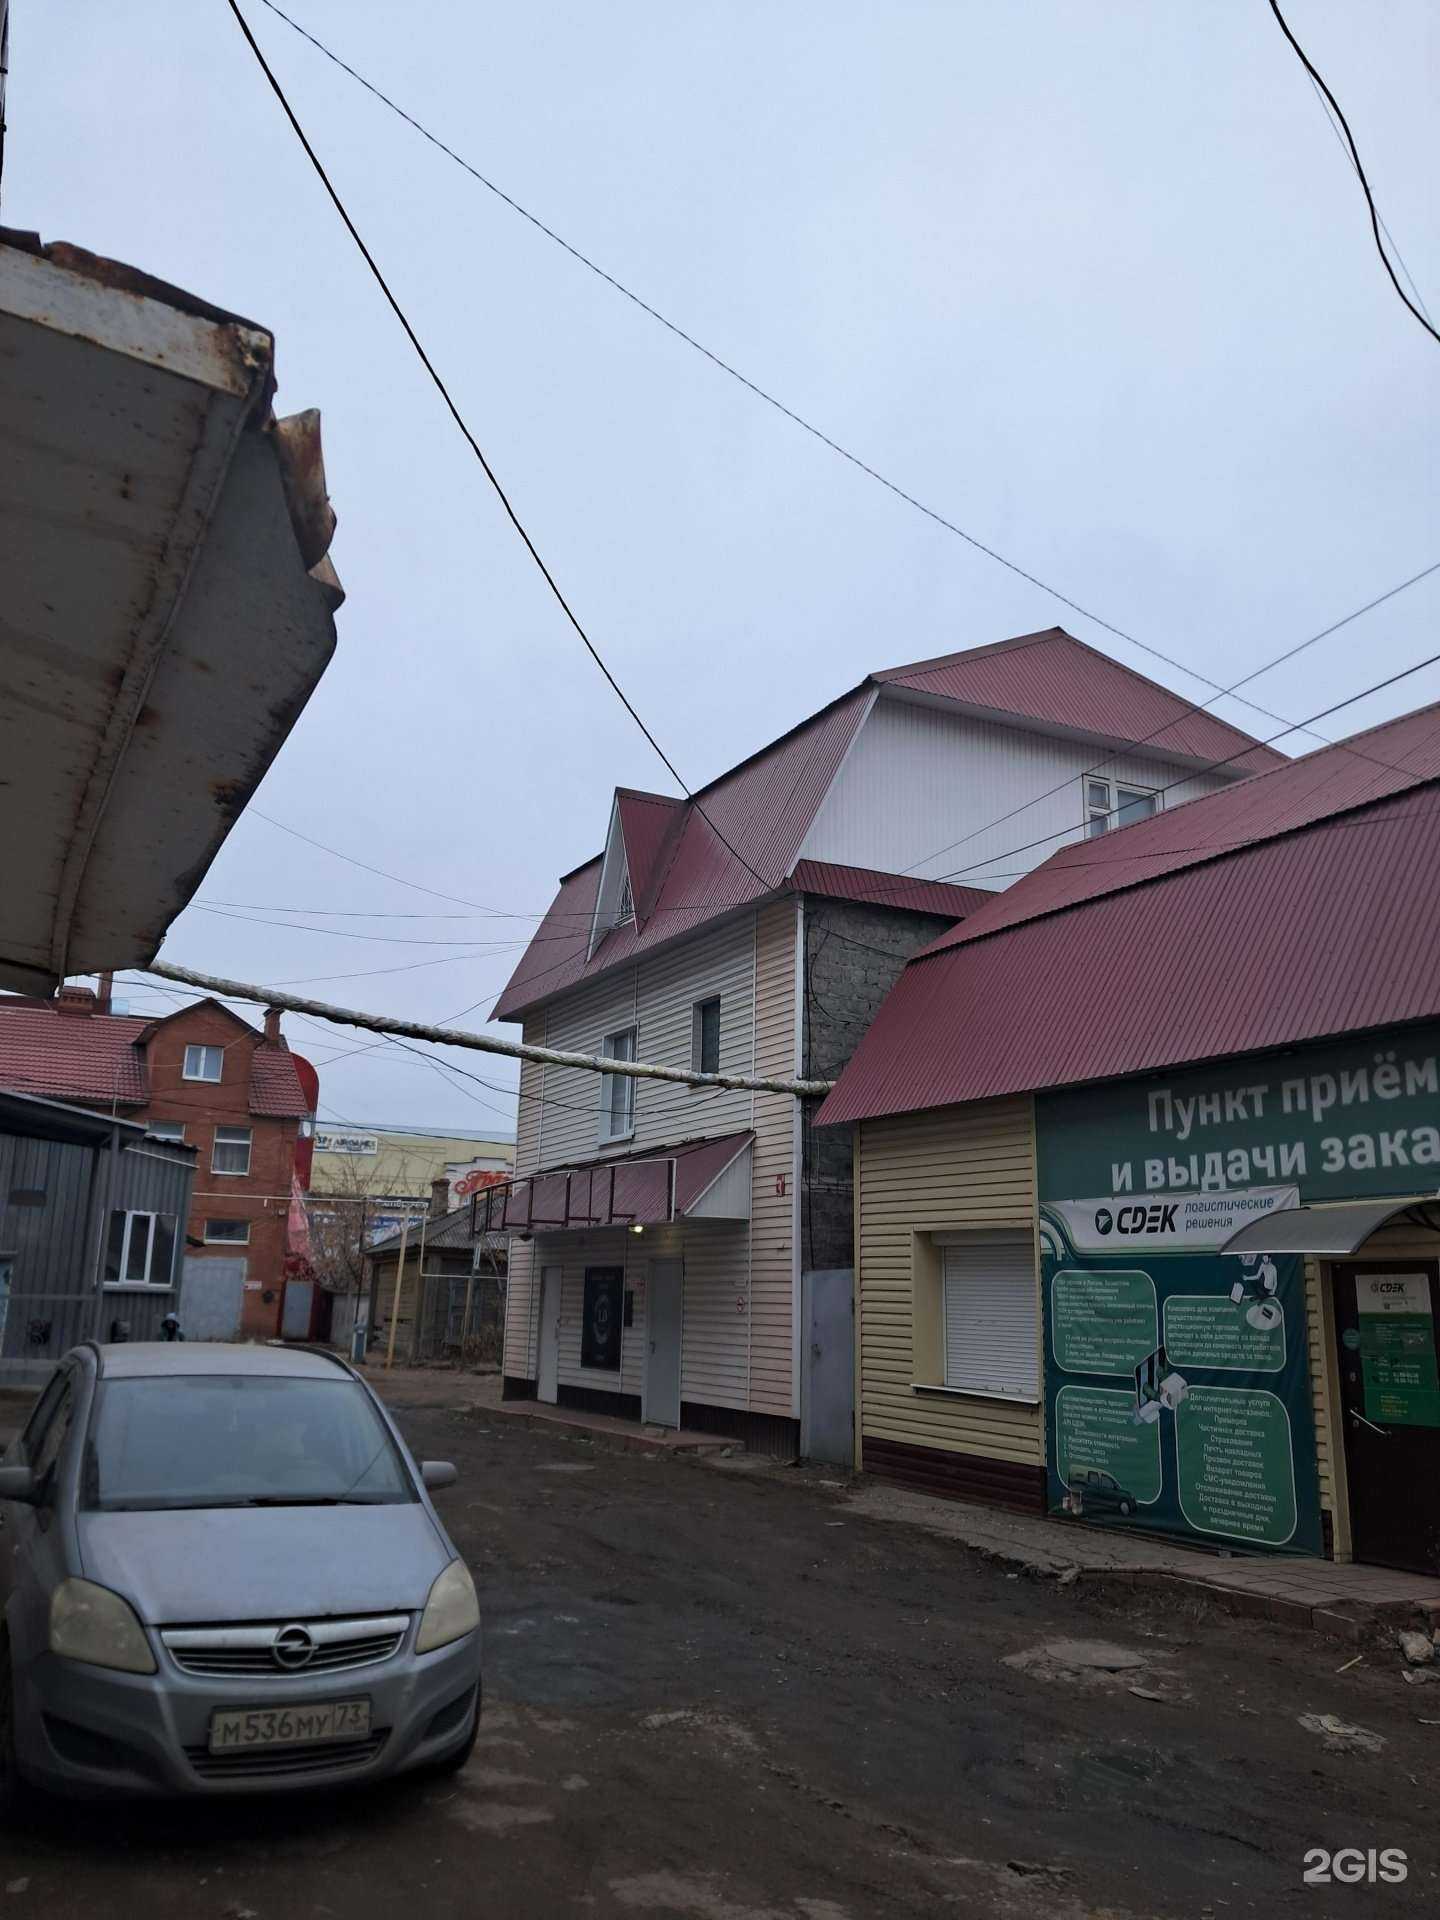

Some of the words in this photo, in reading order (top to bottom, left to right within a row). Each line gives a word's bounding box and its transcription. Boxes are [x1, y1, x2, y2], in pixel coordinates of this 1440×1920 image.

[1147, 1084, 1269, 1140] Пункт
[1281, 1051, 1439, 1123] приём
[1111, 1162, 1133, 1192] и
[1144, 1141, 1307, 1193] выдачи
[1320, 1125, 1440, 1173] зака
[1117, 1204, 1179, 1234] CDEK
[1184, 1197, 1274, 1214] логистические
[1185, 1216, 1233, 1232] решения
[338, 1704, 362, 1728] 73
